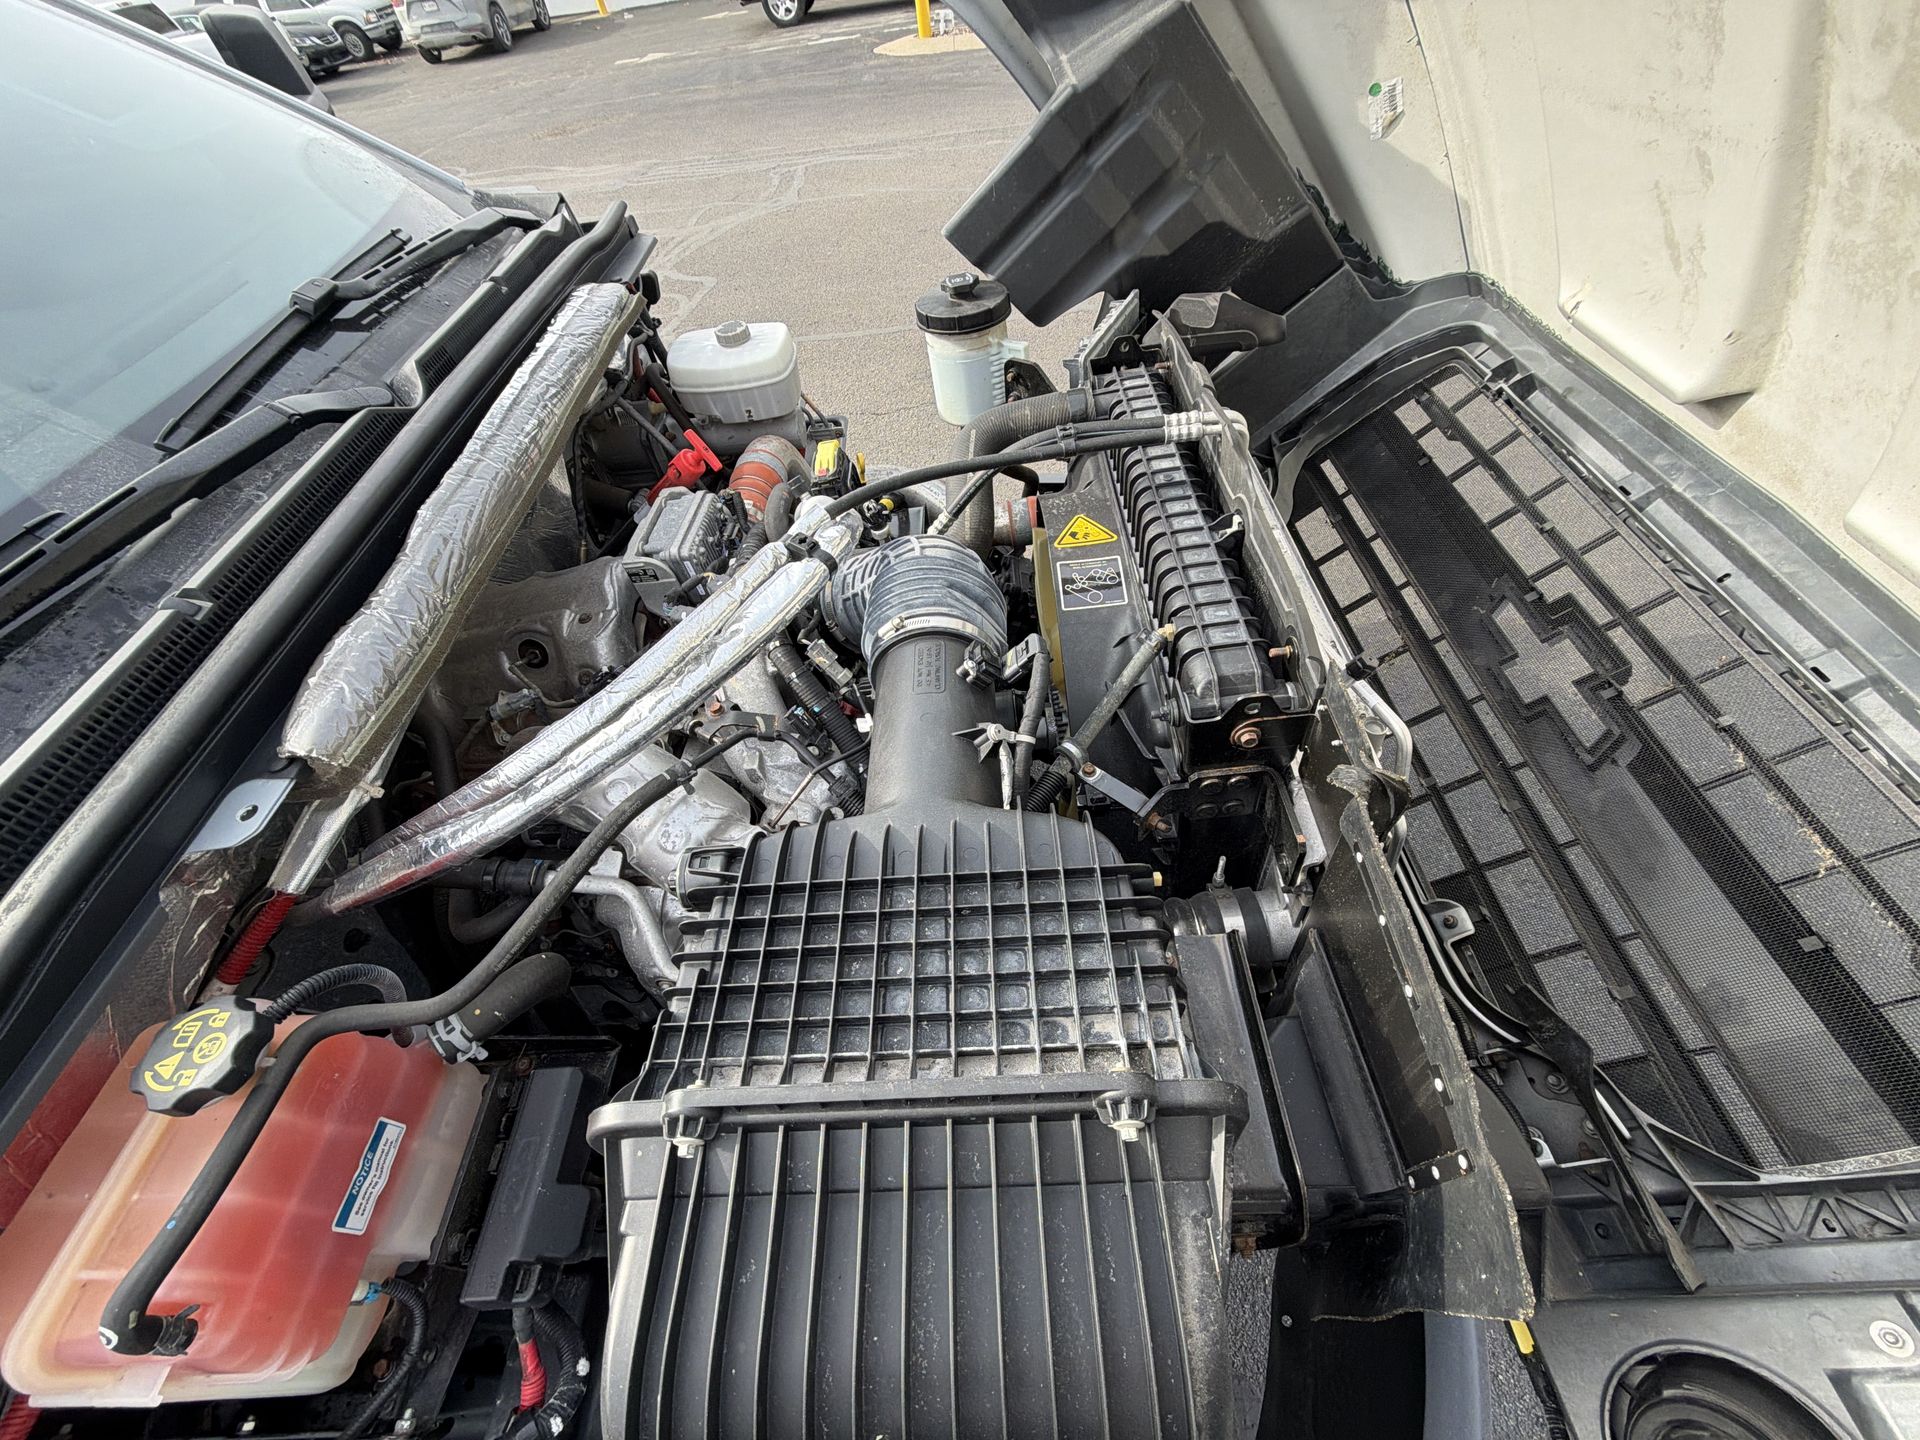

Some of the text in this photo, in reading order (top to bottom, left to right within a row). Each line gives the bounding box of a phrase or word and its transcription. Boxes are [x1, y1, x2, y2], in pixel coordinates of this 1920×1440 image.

[351, 1150, 374, 1195] NOTICE
[355, 1201, 363, 1216] See
[361, 1173, 377, 1201] owner's
[375, 1149, 385, 1173] manual
[360, 1191, 373, 1216] service
